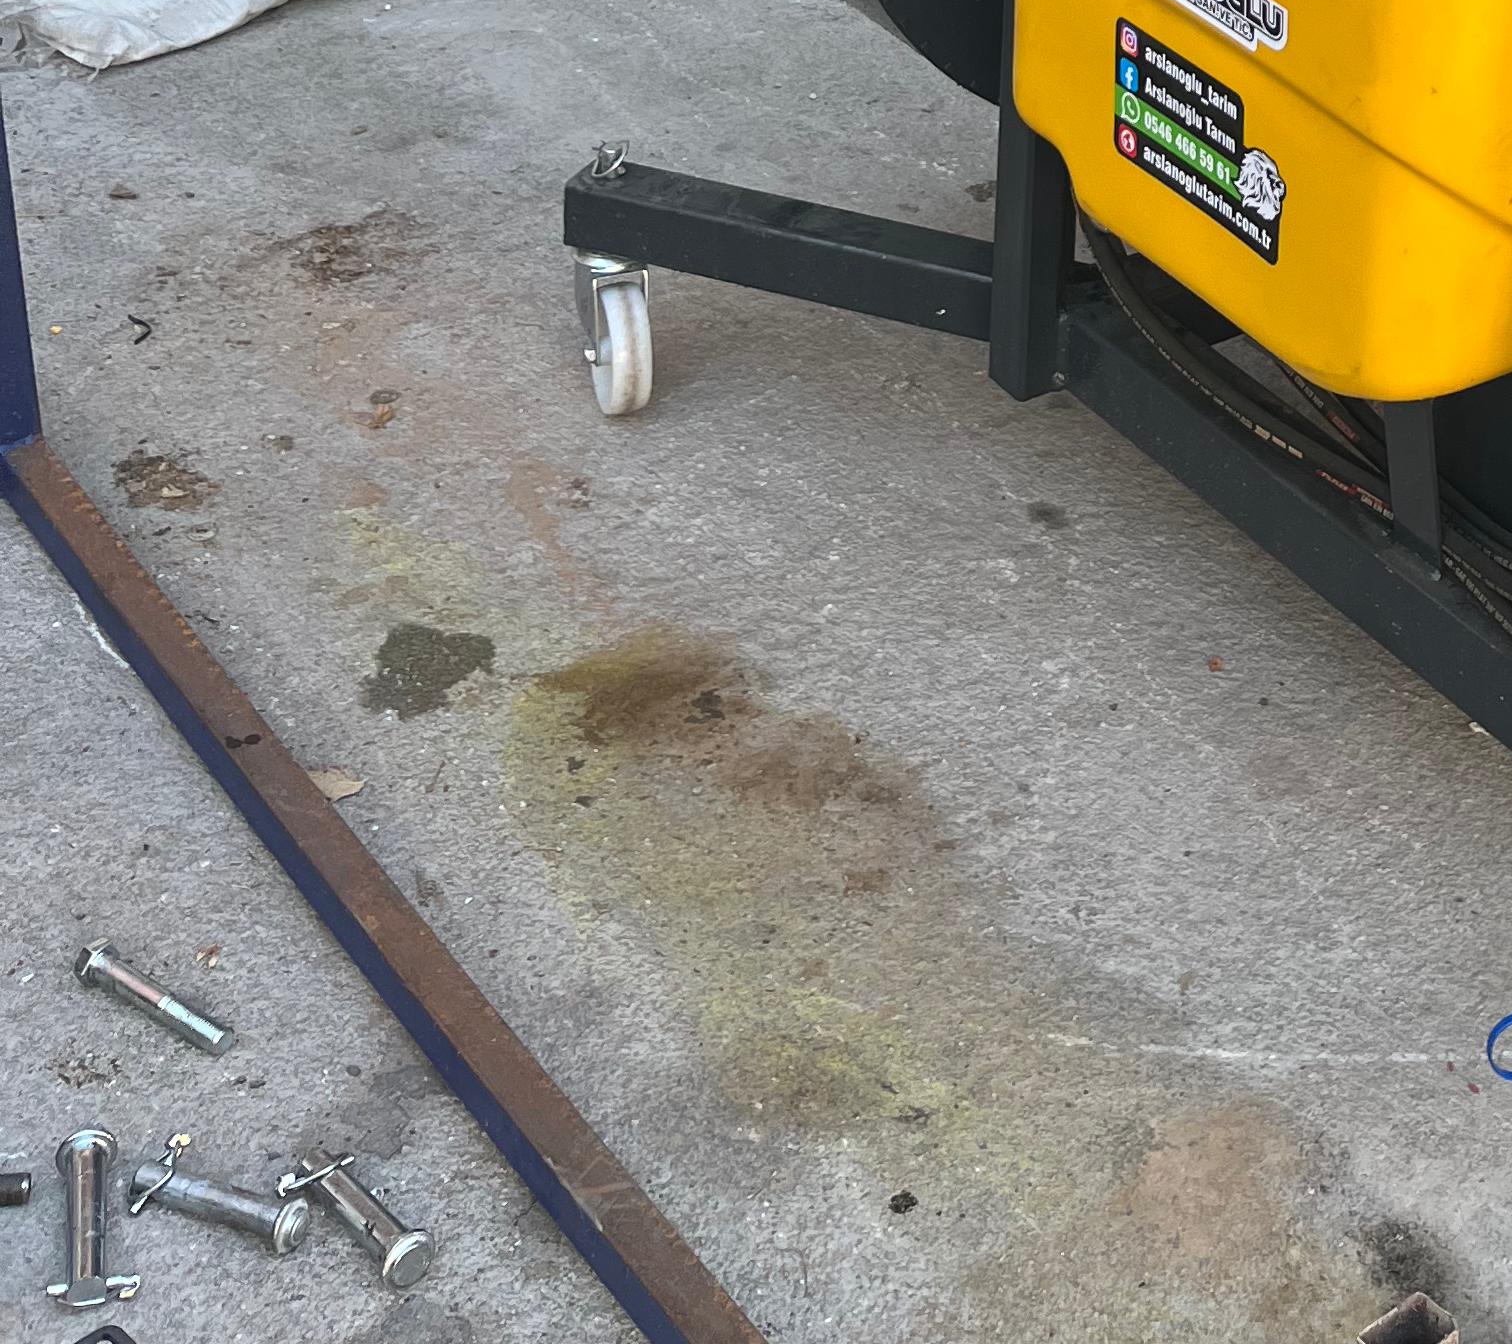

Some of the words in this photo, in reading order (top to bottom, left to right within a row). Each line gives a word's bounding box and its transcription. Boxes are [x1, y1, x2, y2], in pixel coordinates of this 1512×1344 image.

[1144, 76, 1204, 128] Arslanoğlu
[1204, 115, 1236, 154] Tarım
[1145, 46, 1238, 121] arslanoglu_tarim
[1144, 112, 1173, 144] 0546
[1175, 132, 1197, 162] 466
[1199, 147, 1214, 171] 59
[1216, 161, 1231, 186] 61
[1143, 145, 1272, 252] arslanoglutarim.com.tr
